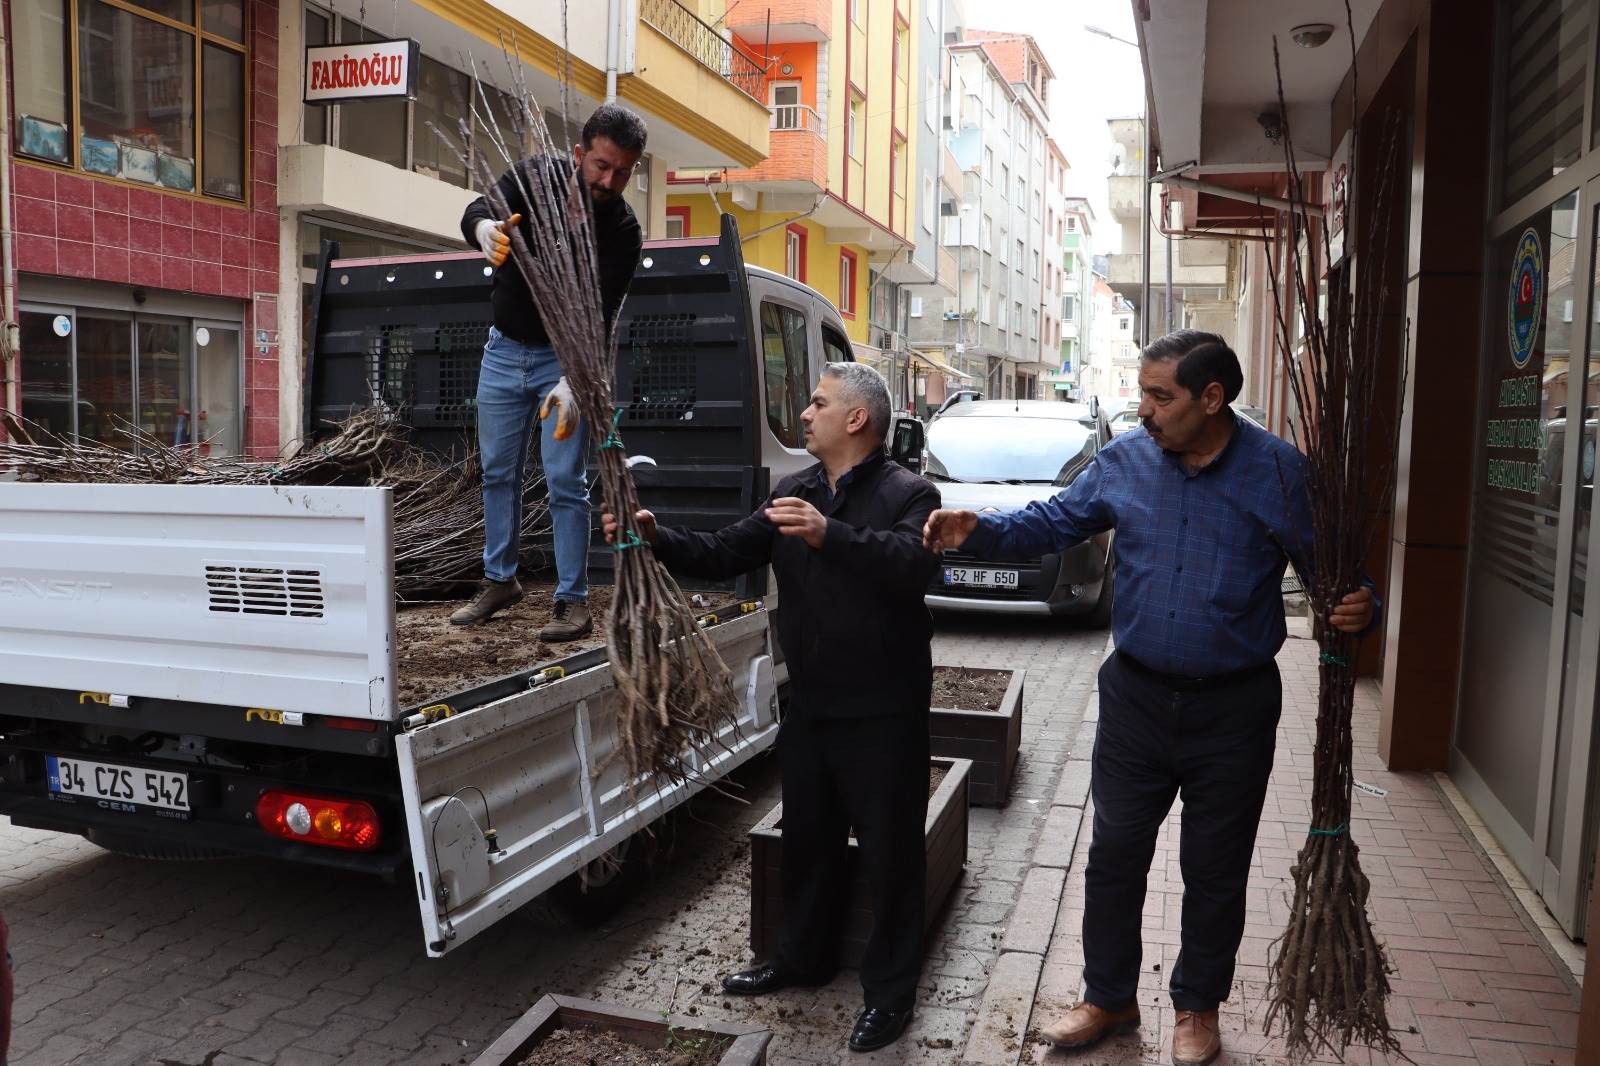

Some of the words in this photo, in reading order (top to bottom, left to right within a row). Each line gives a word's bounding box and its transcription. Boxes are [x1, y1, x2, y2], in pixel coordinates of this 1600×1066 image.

[310, 52, 403, 90] FAKİROĞLU
[953, 569, 967, 582] 52
[973, 570, 987, 583] HF
[994, 571, 1016, 584] 650
[60, 761, 85, 792] 34
[94, 766, 134, 799] CZS
[145, 773, 187, 807] 542
[97, 800, 136, 813] CEM
